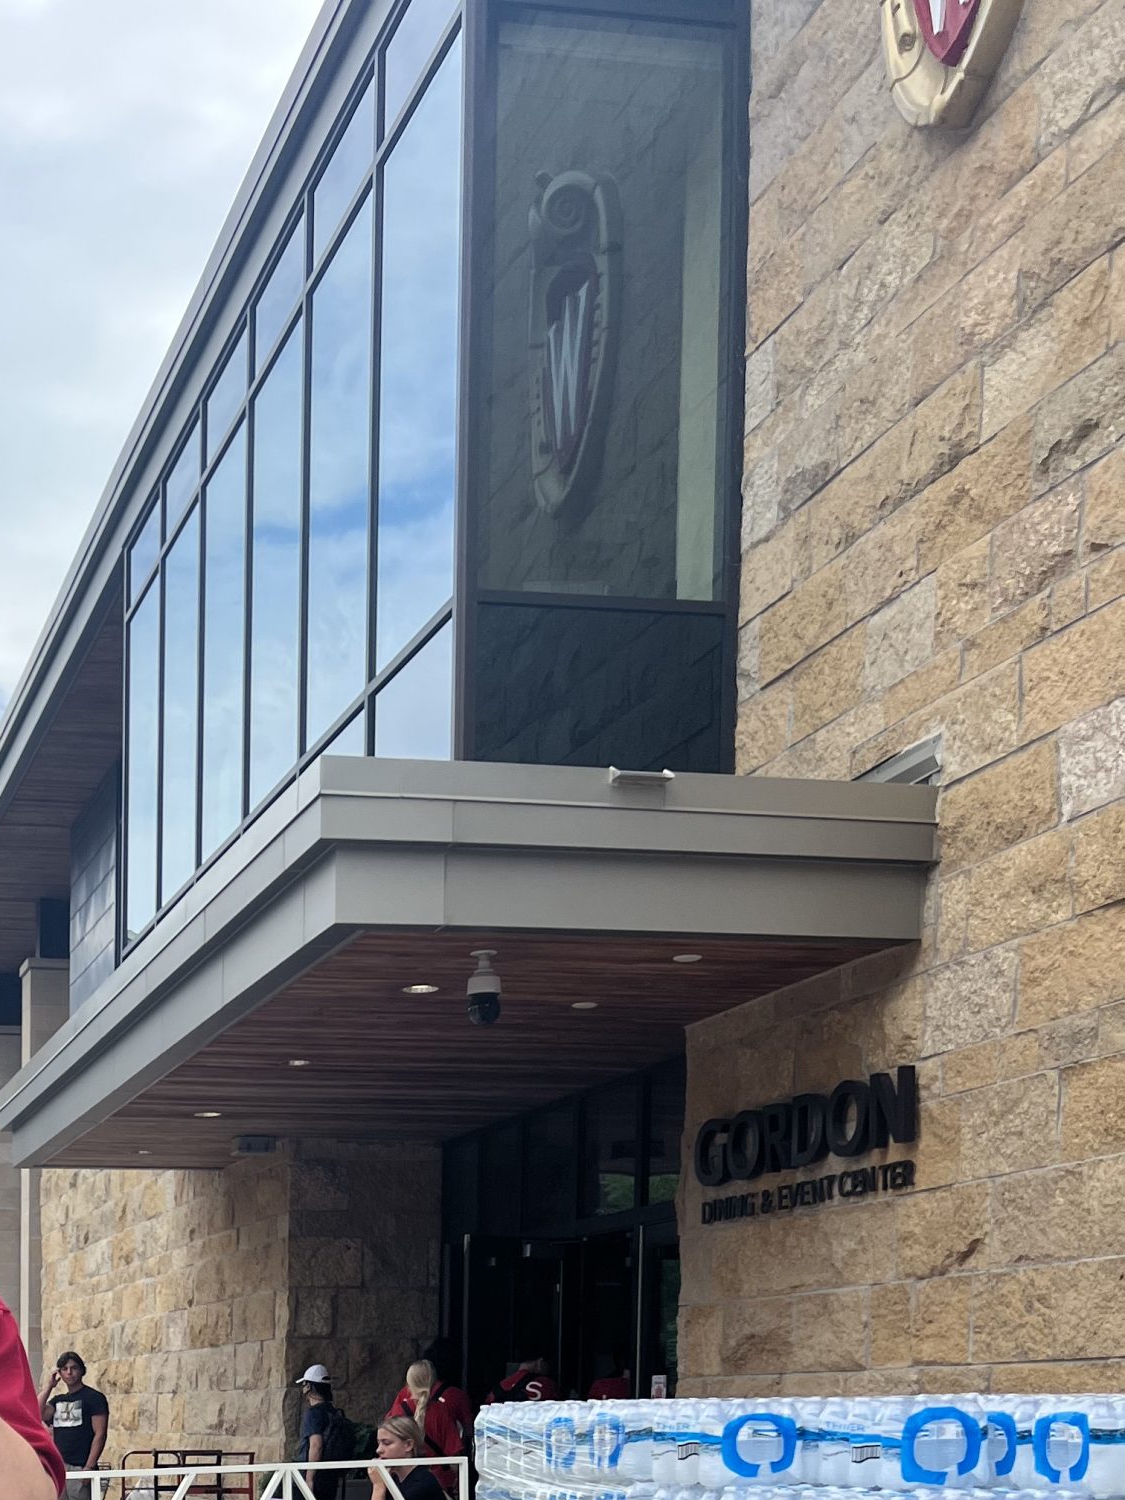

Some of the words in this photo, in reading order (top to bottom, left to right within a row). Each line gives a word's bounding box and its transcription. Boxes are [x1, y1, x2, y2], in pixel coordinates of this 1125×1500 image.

[694, 1065, 916, 1187] GORDON
[701, 1192, 756, 1224] DINING
[761, 1190, 773, 1214] &
[778, 1174, 837, 1210] EVENT
[838, 1160, 916, 1197] CENTER
